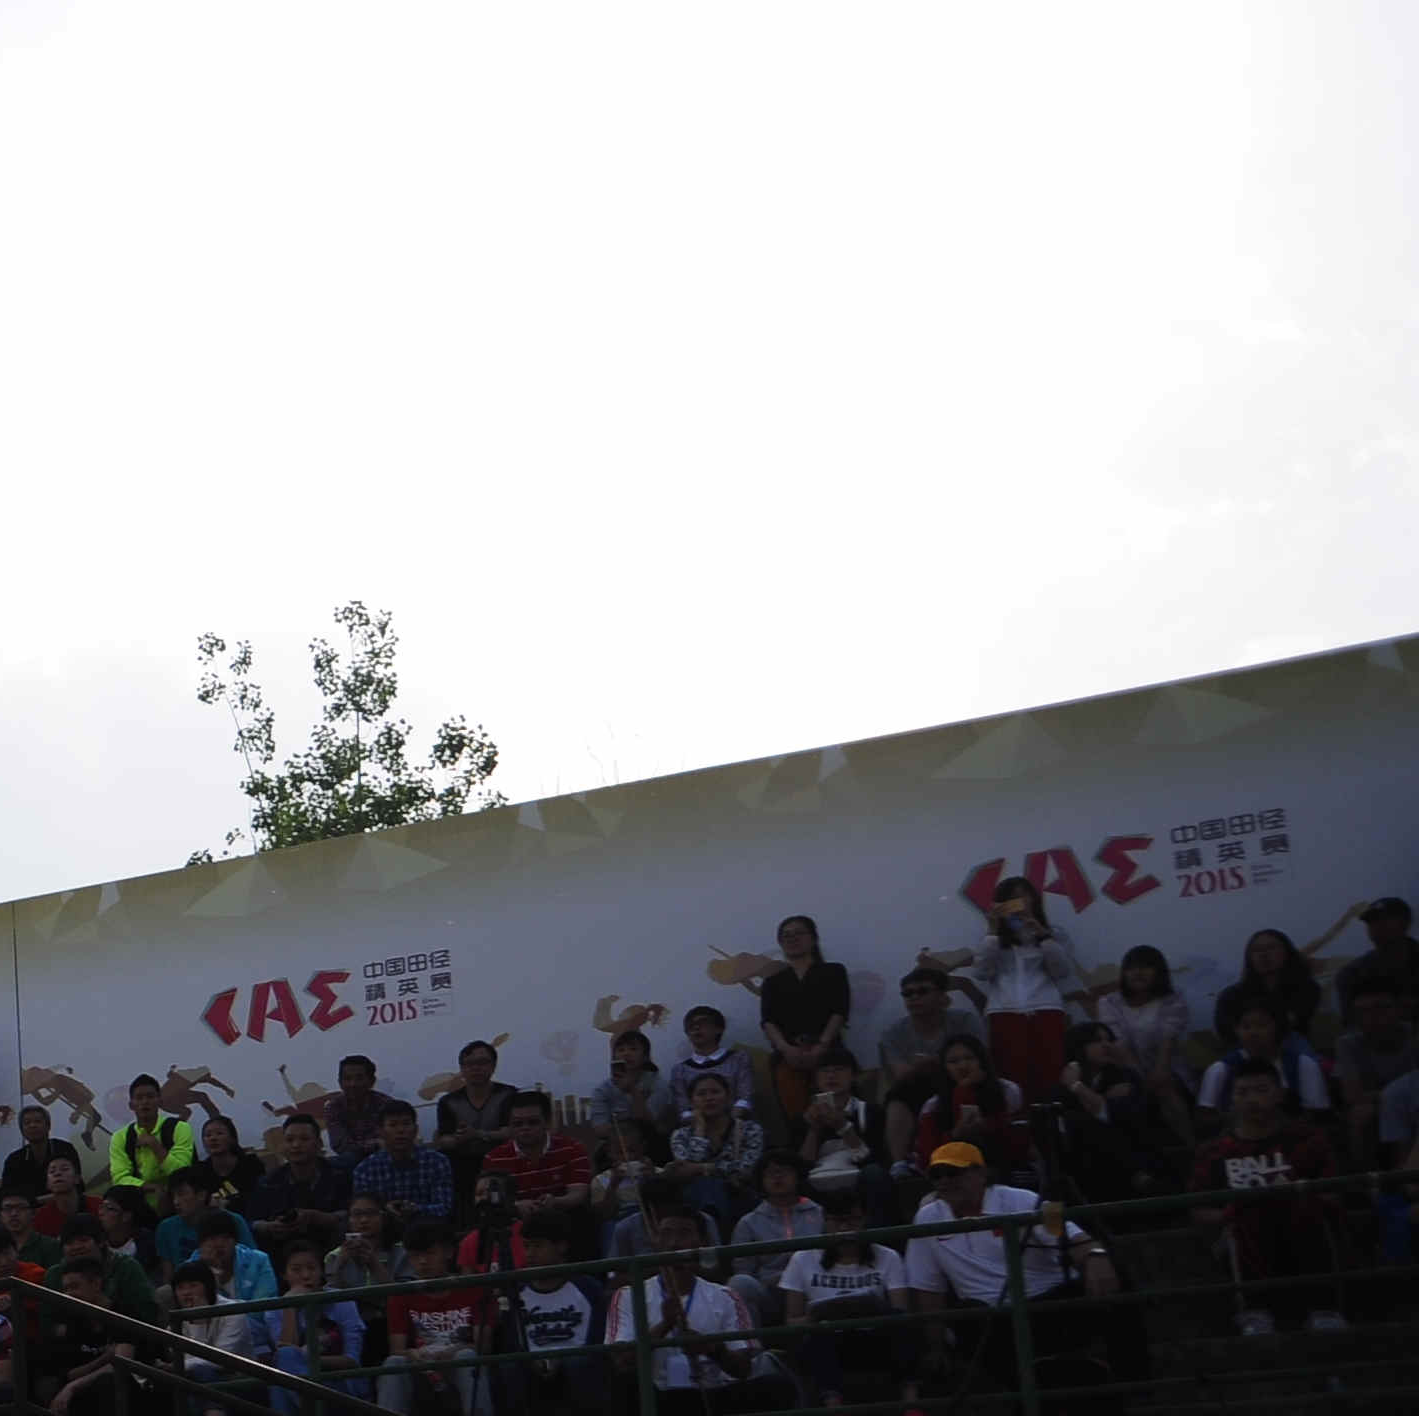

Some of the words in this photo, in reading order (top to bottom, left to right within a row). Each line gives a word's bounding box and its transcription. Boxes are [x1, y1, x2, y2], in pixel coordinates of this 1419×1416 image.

[1171, 809, 1287, 843] 中国田径
[1176, 866, 1246, 897] 2015
[363, 950, 451, 978] 中国田径
[365, 972, 452, 1001] 精英赛
[367, 999, 417, 1026] 2015
